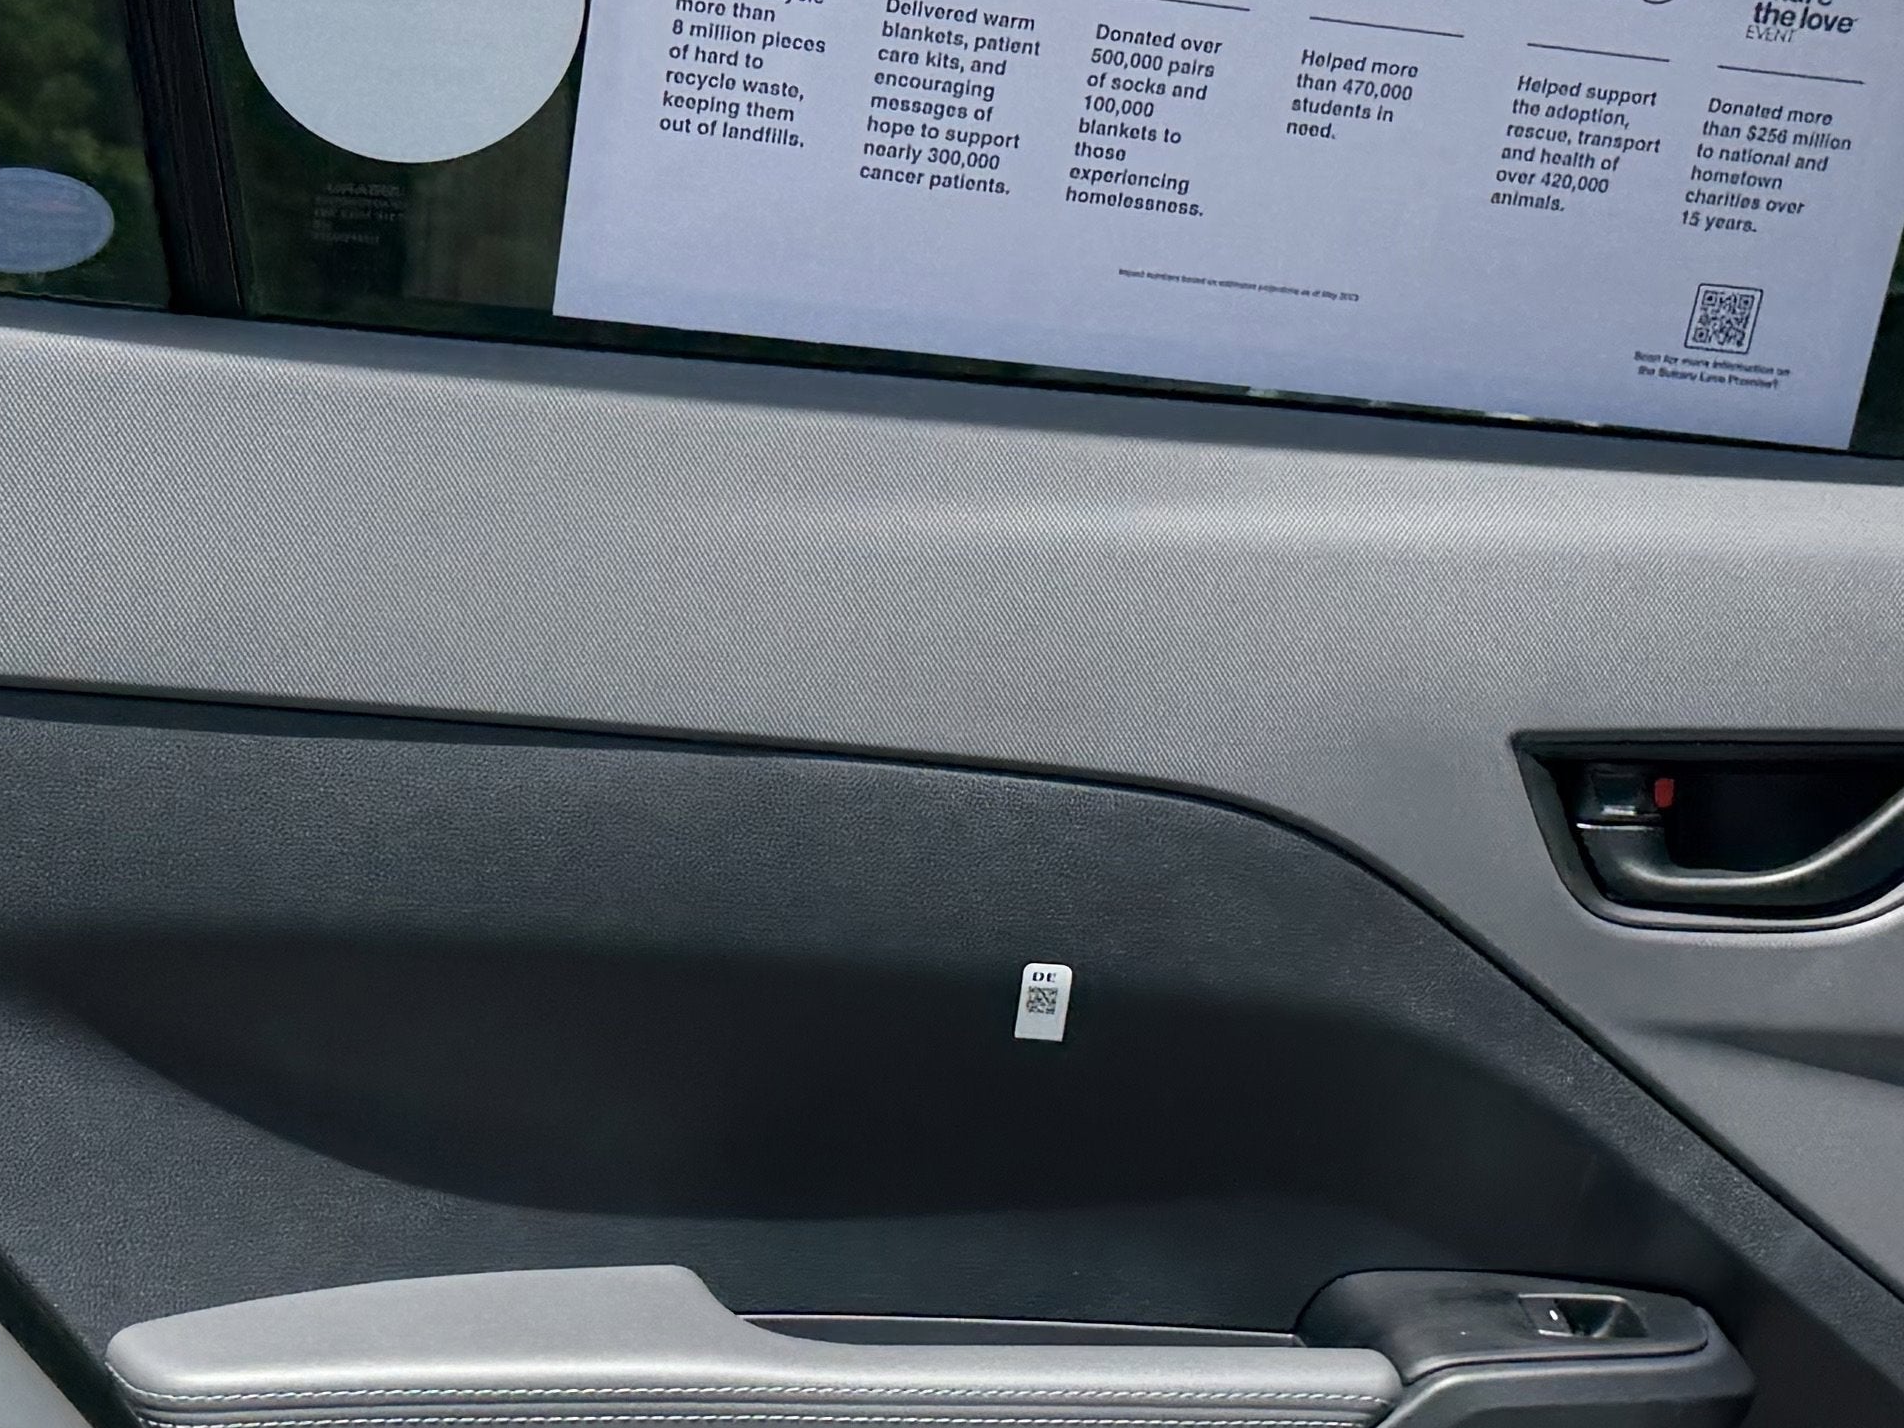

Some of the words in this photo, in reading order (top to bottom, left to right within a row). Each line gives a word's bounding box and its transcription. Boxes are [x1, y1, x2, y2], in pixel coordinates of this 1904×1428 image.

[732, 2, 776, 23] than
[983, 12, 1035, 31] warm
[1753, 1, 1796, 27] the
[1799, 6, 1854, 33] love
[671, 18, 684, 36] 8
[689, 22, 756, 45] million
[761, 30, 826, 53] pieces
[881, 20, 969, 51] blankets,
[973, 36, 1041, 57] patient
[1095, 23, 1176, 49] Donated
[1180, 38, 1223, 55] over
[668, 43, 690, 61] of
[694, 45, 739, 67] hard
[744, 52, 764, 70] to
[877, 48, 920, 65] care
[925, 50, 965, 74] kits,
[970, 59, 1007, 76] and
[1090, 47, 1164, 72] 500,000
[1167, 59, 1215, 78] pairs
[1301, 49, 1368, 73] Helped
[1370, 61, 1419, 78] more
[665, 70, 737, 91] recycle
[742, 78, 804, 102] waste,
[873, 72, 995, 103] encouraging
[1086, 71, 1108, 89] of
[1110, 77, 1167, 96] socks
[1171, 84, 1208, 101] and
[1296, 73, 1337, 93] than
[1342, 78, 1413, 101] 470,000
[1517, 75, 1583, 99] Helped
[1585, 86, 1658, 107] support
[662, 89, 741, 120] keeping
[746, 101, 795, 122] them
[870, 95, 968, 121] messages
[973, 106, 994, 123] of
[1084, 94, 1155, 118] 100,000
[1291, 97, 1371, 120] students
[1376, 104, 1394, 123] in
[1512, 98, 1541, 117] the
[1544, 104, 1630, 130] adoption,
[1707, 97, 1784, 121] Donated
[1786, 110, 1833, 126] more
[659, 117, 692, 134] out
[696, 119, 718, 137] of
[722, 121, 804, 148] landfills.
[866, 114, 916, 139] hope
[920, 122, 940, 140] to
[944, 128, 1020, 150] support
[1078, 117, 1157, 142] blankets
[1163, 127, 1182, 144] to
[1286, 122, 1336, 140] need.
[1506, 124, 1572, 146] rescue,
[1577, 130, 1661, 154] transport
[1702, 120, 1742, 139] than
[1792, 131, 1852, 151] million
[863, 142, 923, 165] nearly
[927, 147, 1001, 171] 300,000
[1074, 141, 1127, 162] those
[1500, 146, 1536, 163] and
[1539, 147, 1596, 170] health
[1600, 155, 1621, 172] of
[1696, 143, 1714, 160] to
[1718, 148, 1791, 168] national
[1794, 155, 1830, 172] and
[859, 165, 926, 185] cancer
[928, 173, 1010, 195] patients.
[1069, 166, 1190, 196] experiencing
[1495, 169, 1537, 186] over
[1540, 171, 1610, 194] 420,000
[1690, 164, 1783, 190] hometown
[1065, 185, 1204, 217] homelessness.
[1490, 190, 1565, 212] animals.
[1684, 188, 1761, 211] charities
[1765, 199, 1806, 215] over
[1682, 209, 1701, 227] 15
[1704, 215, 1758, 233] years.
